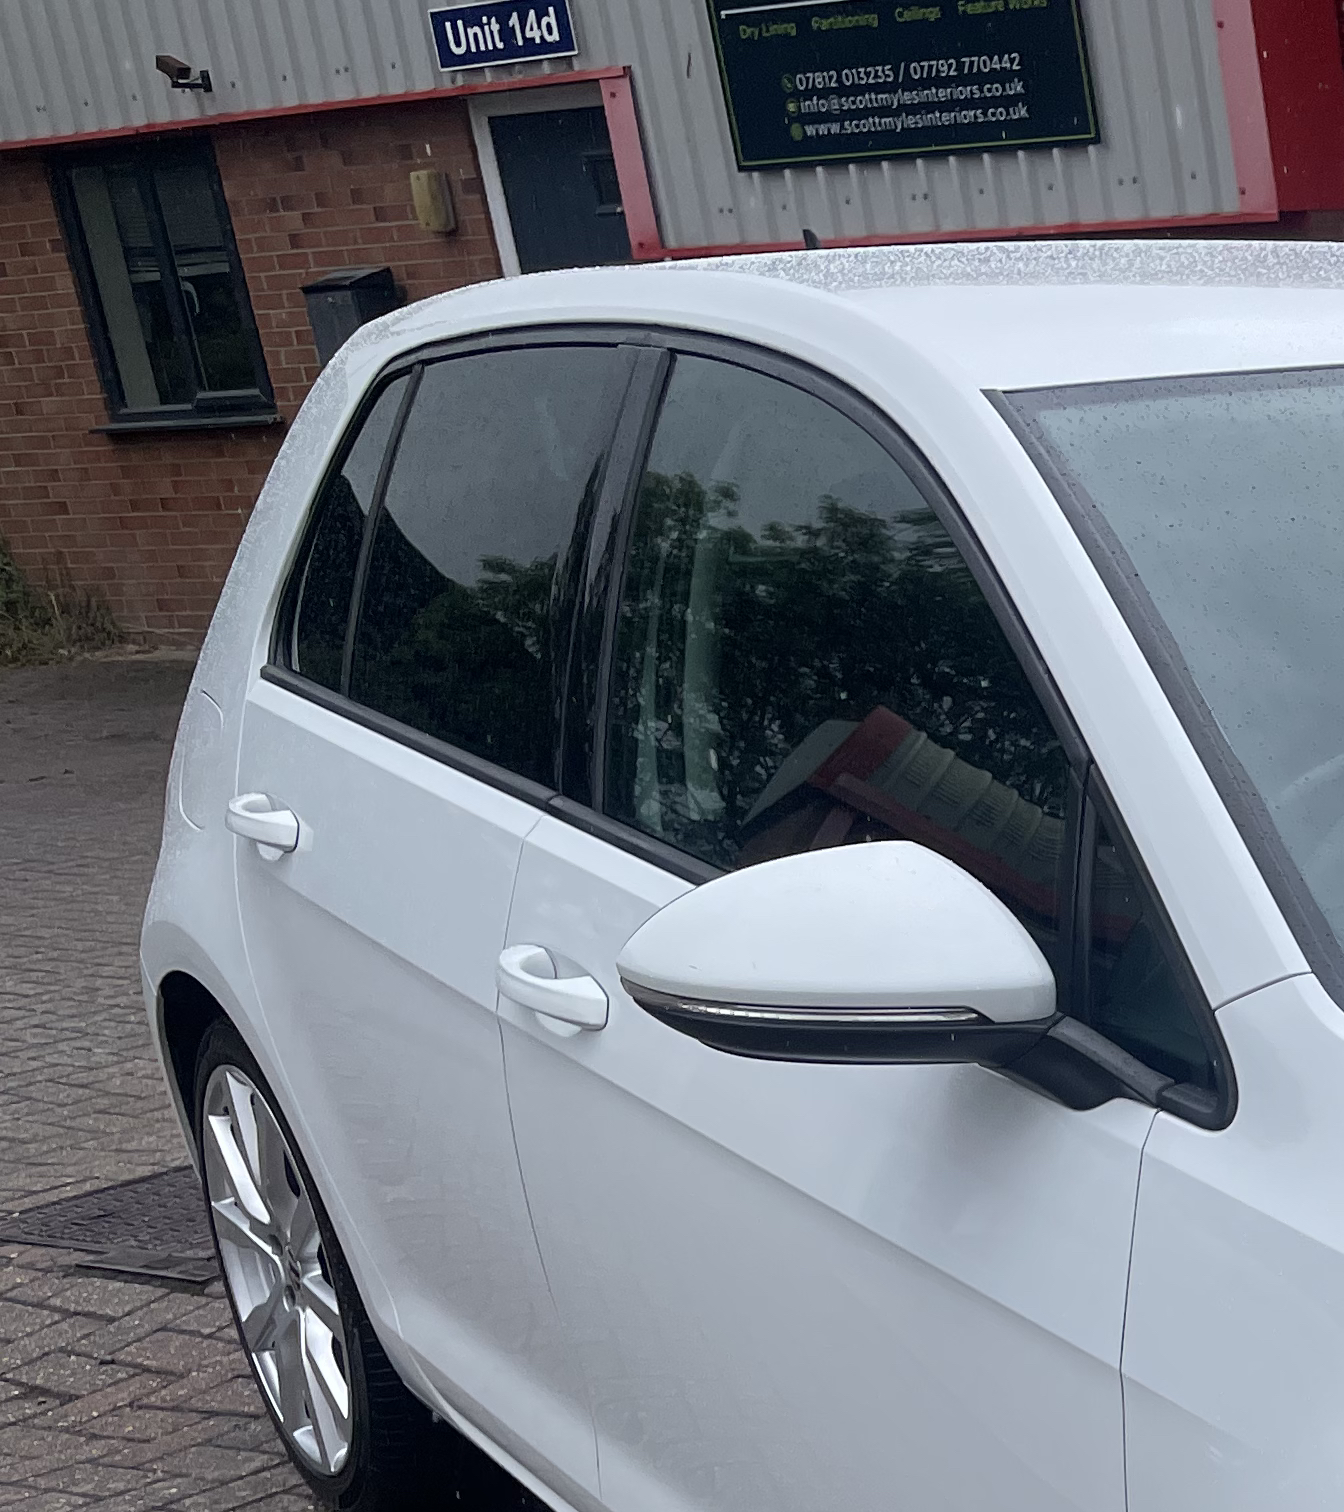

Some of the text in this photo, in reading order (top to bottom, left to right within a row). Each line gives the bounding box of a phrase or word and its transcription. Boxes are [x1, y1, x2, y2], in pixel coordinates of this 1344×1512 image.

[445, 6, 560, 55] Unit 14d
[795, 70, 839, 91] 07812
[841, 64, 894, 86] 013235
[909, 58, 958, 80] 07792
[960, 52, 1022, 75] 770442
[800, 77, 1025, 114] info@scottmylesinteriors.co.uk
[804, 101, 1030, 139] www.scottmylesinteriors.co.uk
